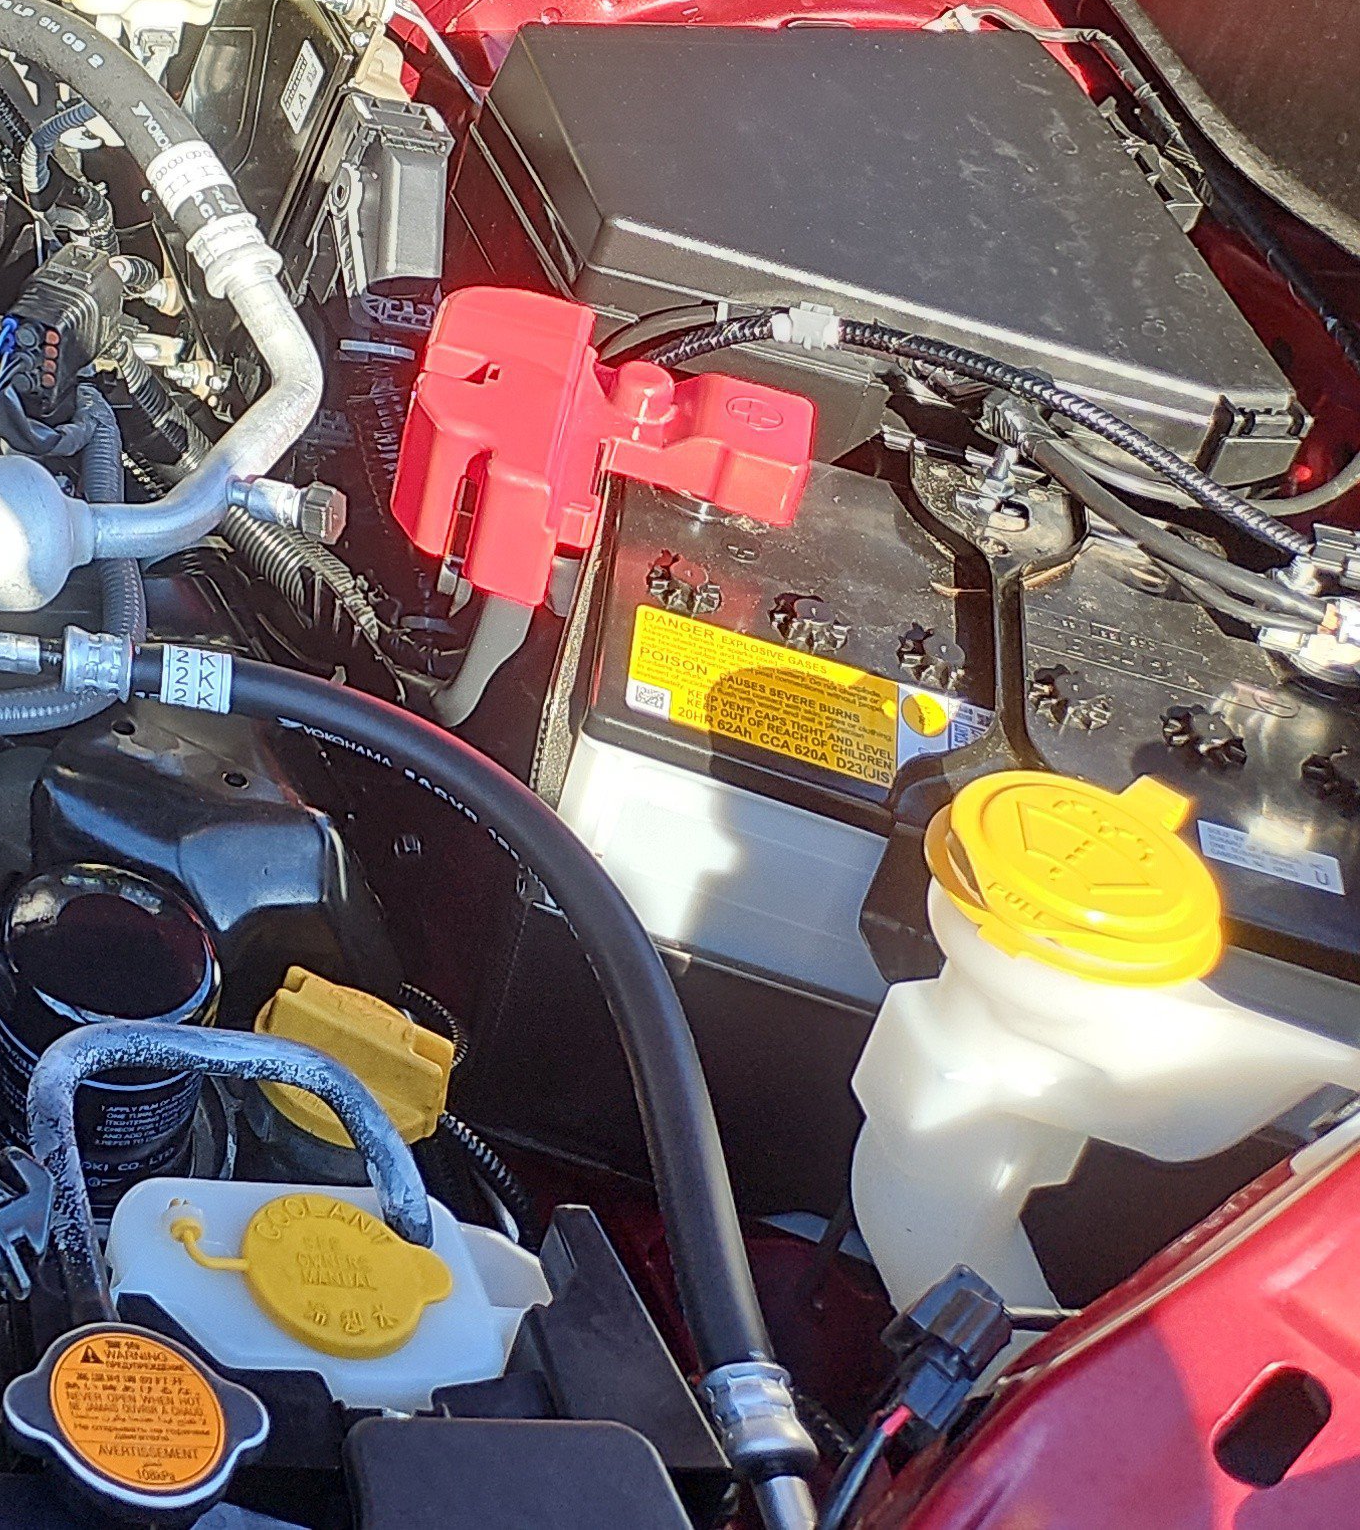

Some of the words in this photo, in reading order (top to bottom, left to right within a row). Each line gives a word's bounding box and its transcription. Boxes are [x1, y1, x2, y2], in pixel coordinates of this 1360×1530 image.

[176, 650, 189, 663] 2
[201, 653, 215, 667] K
[644, 611, 714, 640] DANGER
[721, 635, 784, 661] EXPLOSIVE
[788, 656, 827, 673] GASES
[175, 667, 188, 685] 2
[199, 670, 215, 689] K
[640, 647, 708, 675] POISON
[720, 672, 766, 695] CAUSES
[769, 687, 816, 709] SEVERE
[819, 703, 860, 722] BURNS
[174, 689, 187, 702] 2
[197, 691, 212, 706] K
[677, 707, 713, 726] 20HR
[717, 720, 753, 739] 62Ah
[760, 732, 791, 753] CCA
[794, 743, 829, 764] 620A
[686, 698, 717, 713] KEEP
[720, 707, 745, 724] OUT
[748, 717, 765, 729] OF
[767, 722, 809, 743] REACH
[812, 735, 827, 747] OF
[831, 743, 893, 770] CHILDREN
[687, 688, 718, 705] KEEP
[720, 698, 751, 716] VENT
[755, 709, 786, 726] CAPS
[789, 719, 826, 739] TIGHT
[829, 733, 854, 748] AND
[855, 741, 894, 760] LEVEL
[255, 1197, 394, 1243] COOLANT
[104, 1349, 168, 1362] WARNING
[107, 1394, 136, 1403] OPEN
[142, 1395, 175, 1405] WHEN
[98, 1444, 199, 1460] AVERTISSEMENT
